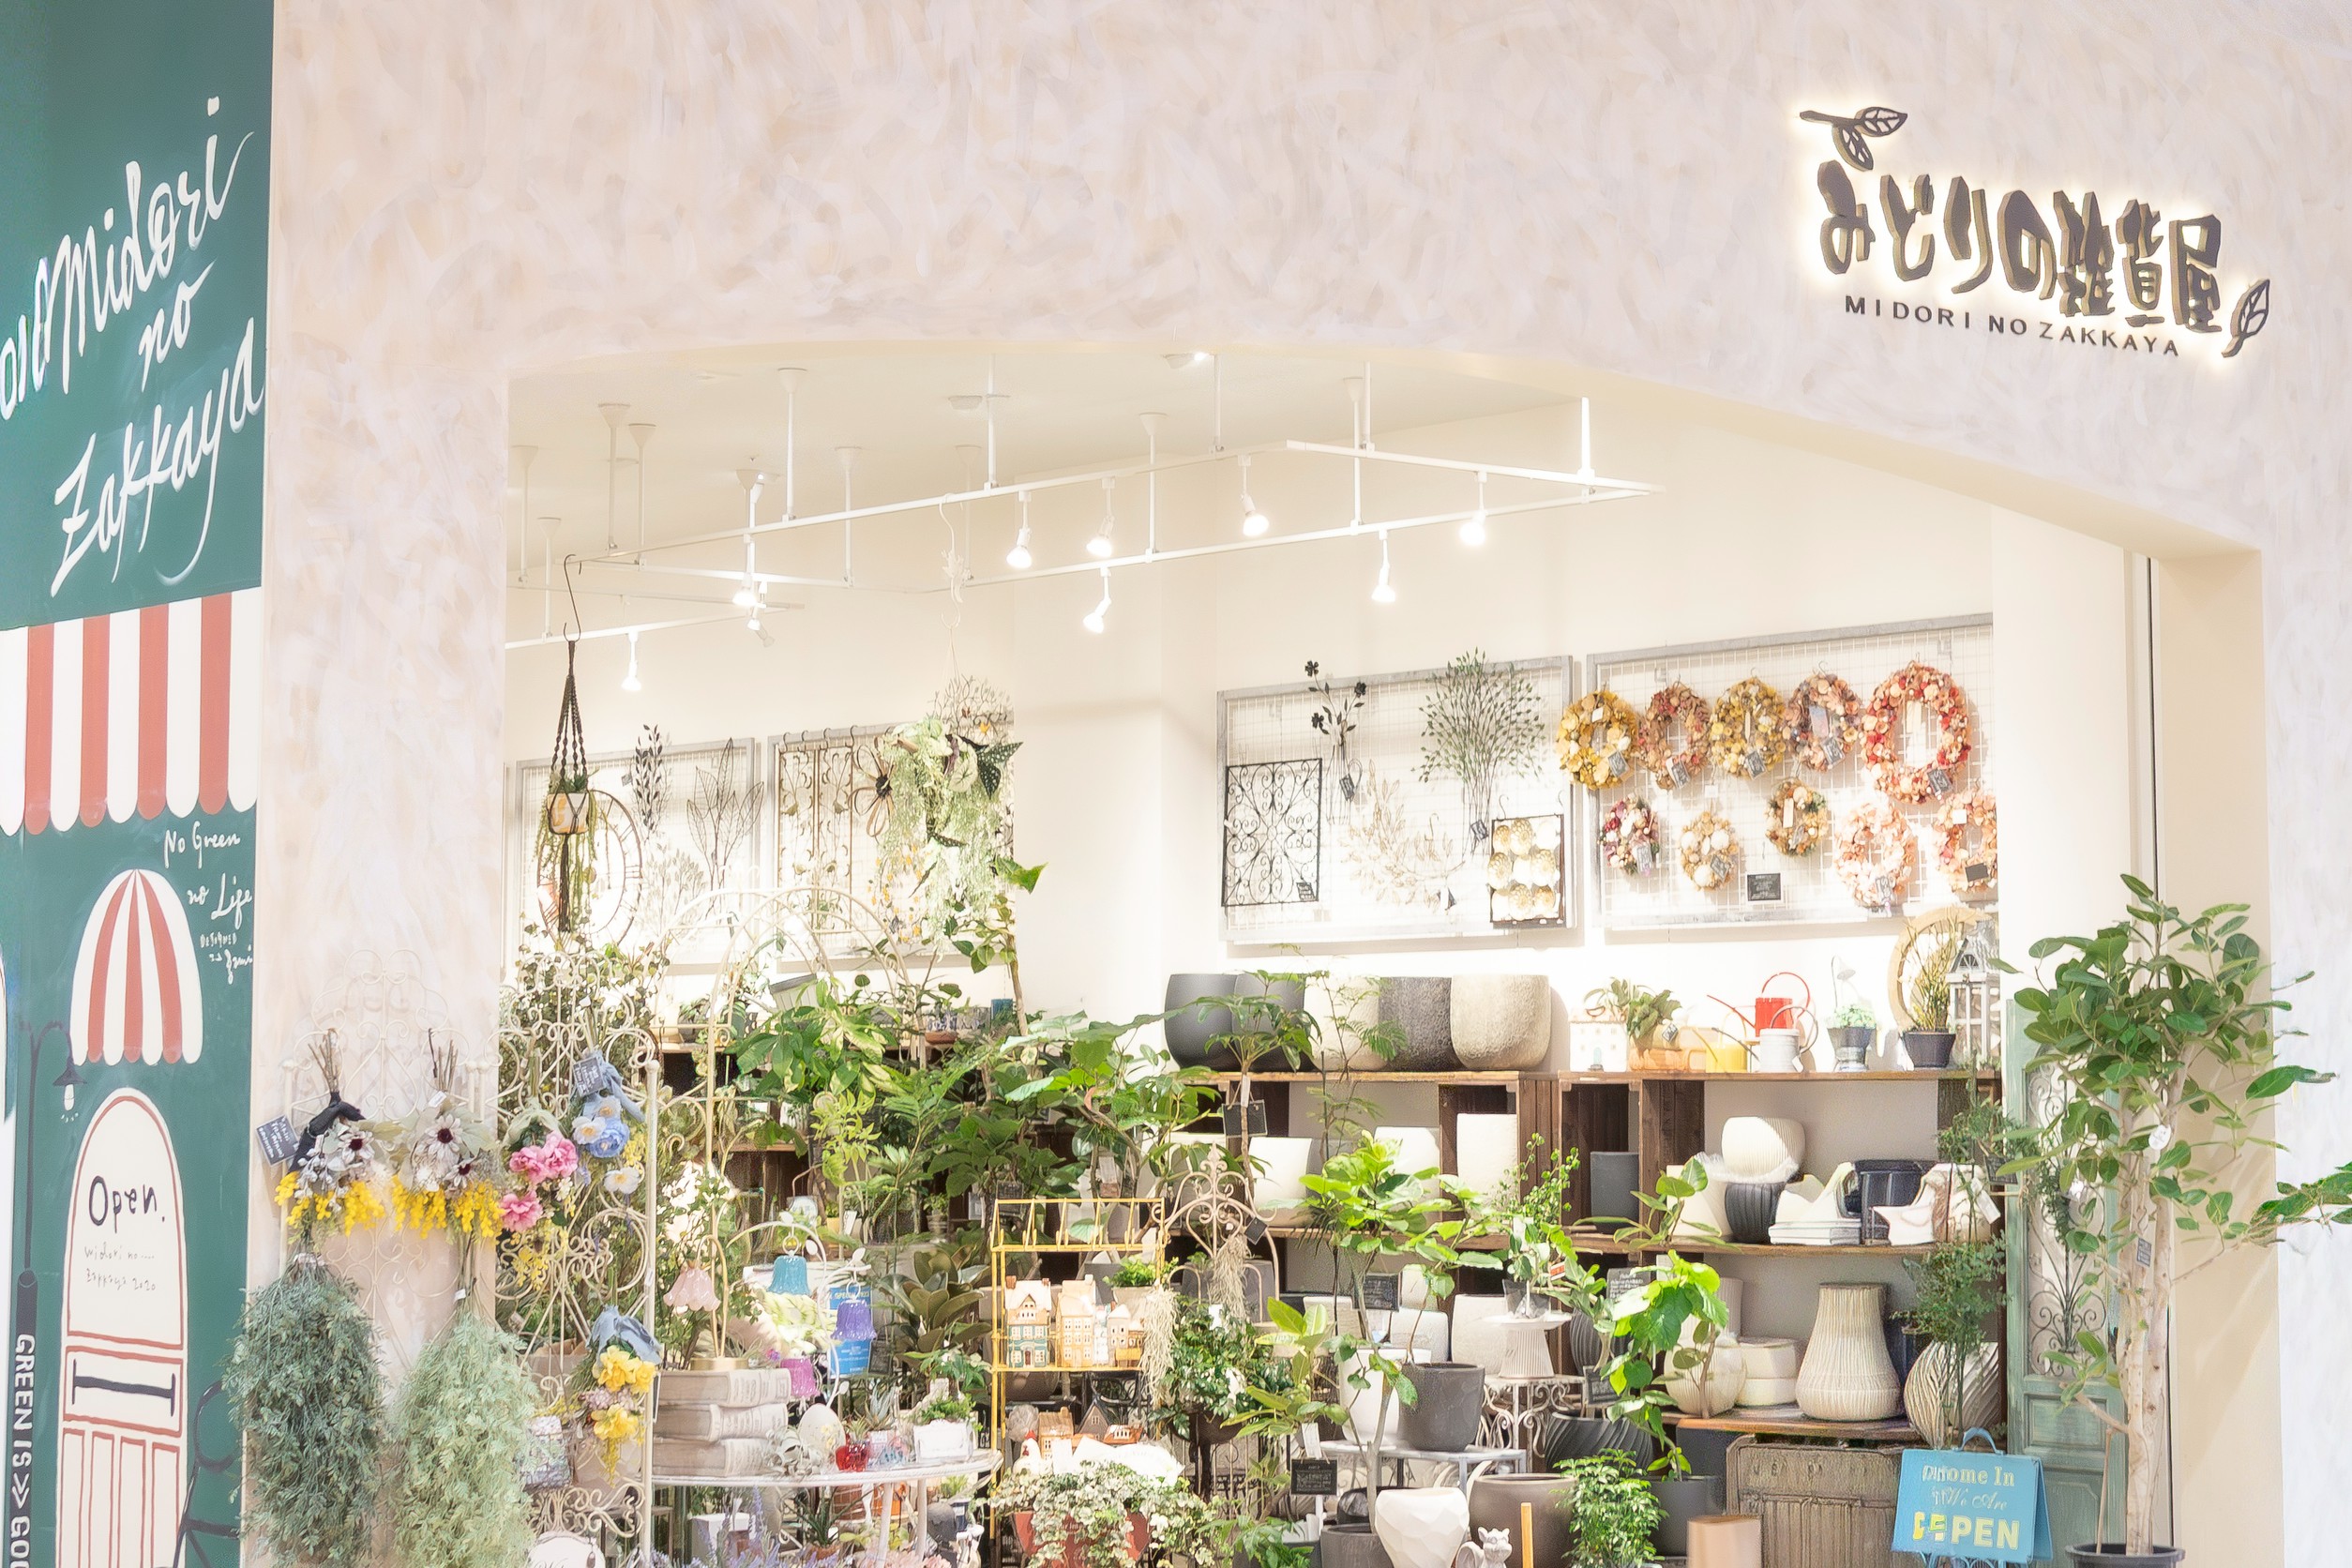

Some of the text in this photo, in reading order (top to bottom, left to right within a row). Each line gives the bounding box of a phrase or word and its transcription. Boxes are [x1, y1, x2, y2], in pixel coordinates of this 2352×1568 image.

[1845, 294, 2179, 357] MIDORI NO ZAKKAYA
[163, 821, 241, 869] No Green
[188, 872, 252, 929] no Life
[14, 1334, 36, 1430] GREEN
[12, 1440, 33, 1468] IS
[1994, 1466, 2015, 1486] In
